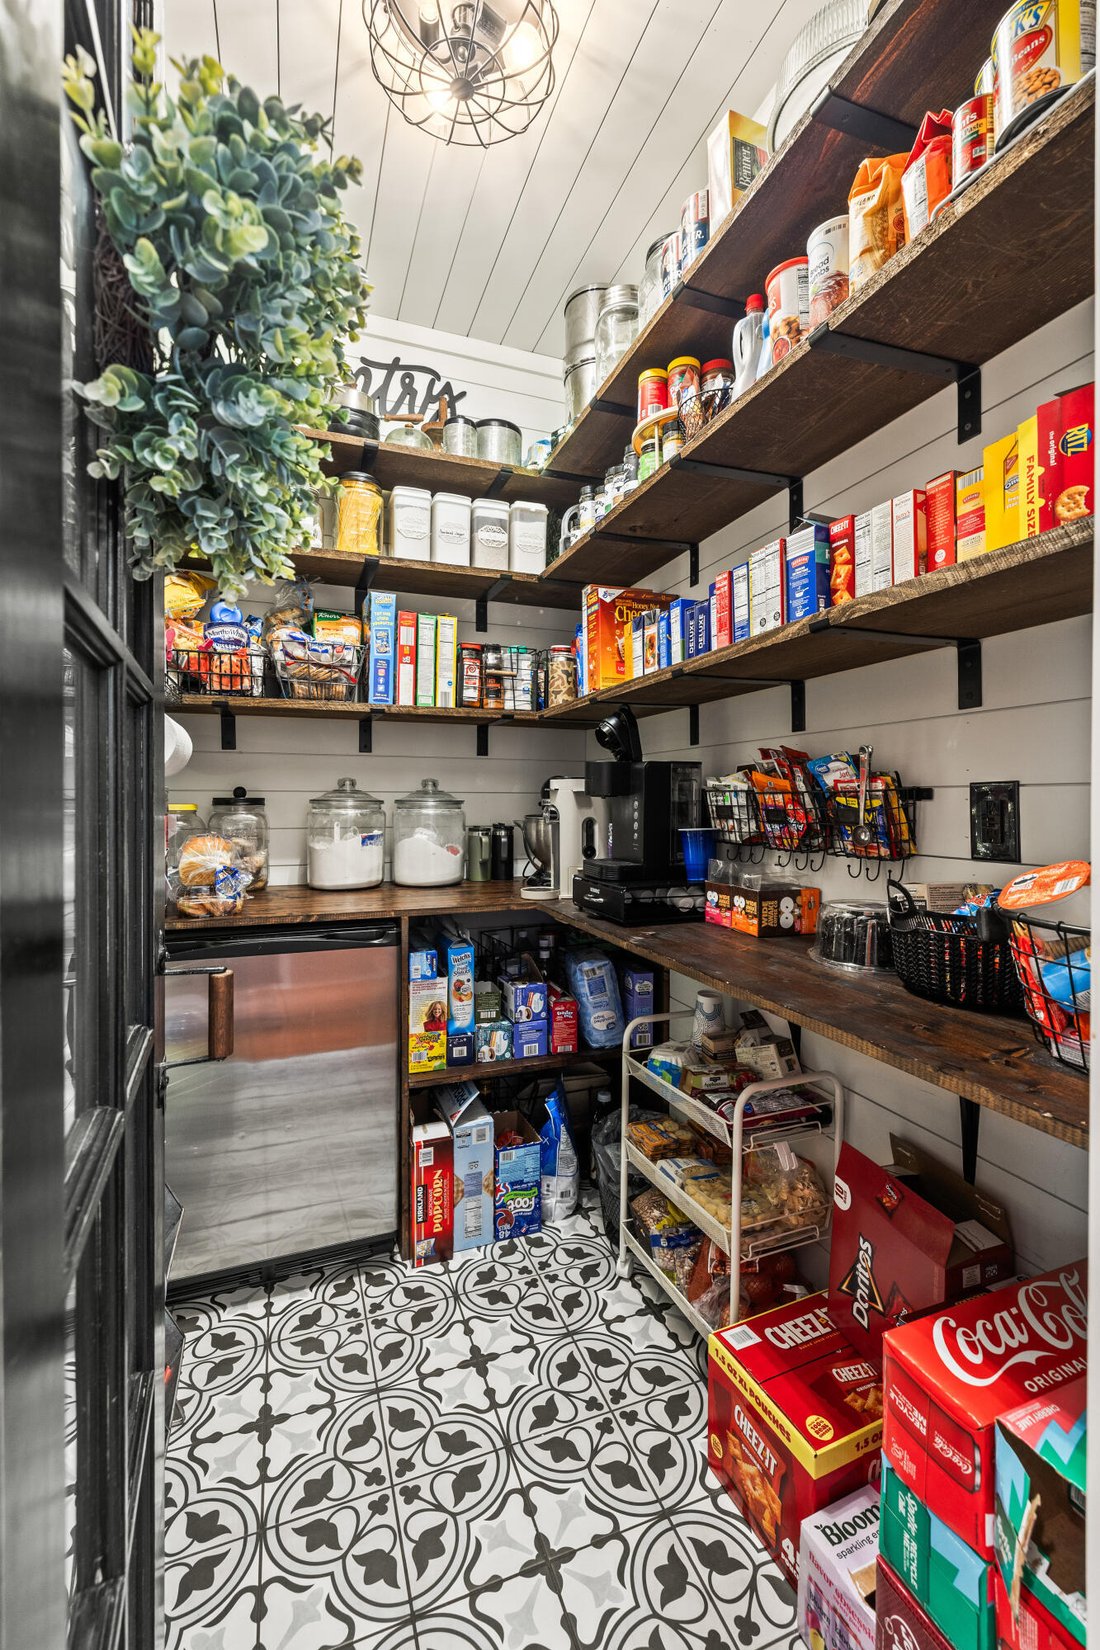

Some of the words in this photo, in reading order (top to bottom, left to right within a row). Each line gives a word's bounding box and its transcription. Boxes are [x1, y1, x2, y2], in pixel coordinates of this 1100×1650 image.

[351, 356, 467, 424] ntry
[1048, 440, 1057, 466] original
[1065, 423, 1089, 457] RITZ
[1026, 454, 1035, 505] FAMILY
[1026, 507, 1036, 538] SIZE
[632, 602, 649, 610] Honey
[698, 613, 706, 649] DELUXE
[433, 1169, 443, 1233] POPCORN
[835, 1183, 844, 1198] 10
[498, 1230, 510, 1239] 48
[853, 1236, 873, 1330] Doritos
[932, 1268, 1088, 1387] Coca-Col
[832, 1362, 878, 1383] CHEEZ-IT
[856, 1382, 877, 1392] ORIGINAL
[1024, 1355, 1088, 1393] ORIGINA
[714, 1347, 726, 1366] 1.5
[726, 1362, 738, 1380] OZ
[738, 1375, 748, 1393] XL
[748, 1388, 791, 1443] POUCHES
[889, 1388, 927, 1436] RECYCLE
[1034, 1404, 1061, 1421] CHERRY
[912, 1406, 927, 1426] ME
[1015, 1413, 1036, 1431] LIME
[734, 1404, 778, 1476] CHEEZ-IT
[855, 1438, 870, 1451] 1.5
[819, 1504, 880, 1547] Bloom
[836, 1534, 874, 1560] sparkling
[909, 1535, 918, 1590] RECYCLE
[808, 1550, 834, 1588] flavor
